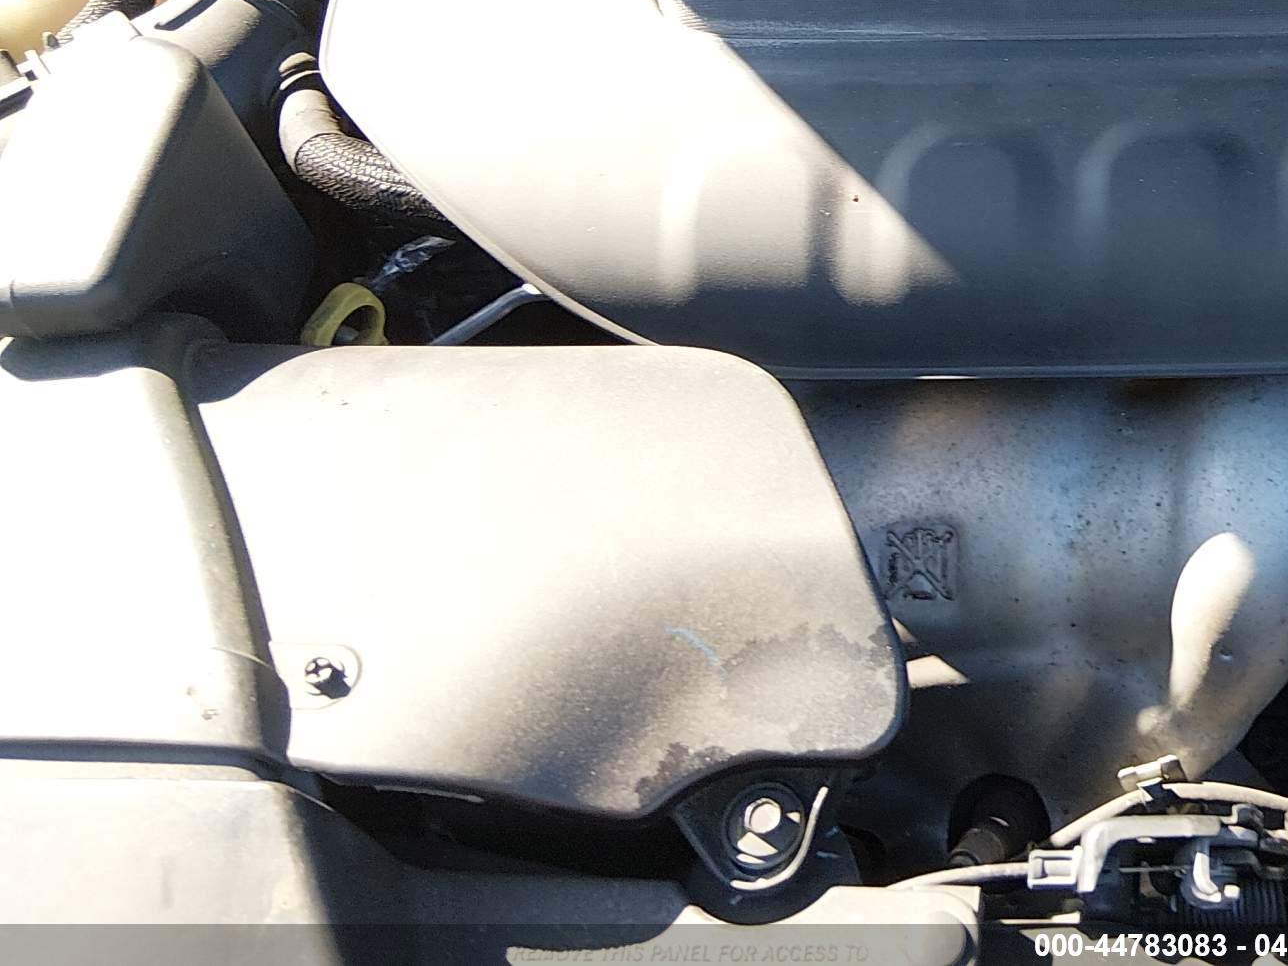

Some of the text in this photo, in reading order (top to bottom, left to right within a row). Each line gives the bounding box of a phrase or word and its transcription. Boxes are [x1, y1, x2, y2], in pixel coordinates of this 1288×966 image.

[602, 945, 645, 962] THIS
[650, 945, 711, 962] PANEL
[718, 945, 758, 962] FOR
[761, 945, 839, 962] ACCESS
[845, 945, 870, 962] TO
